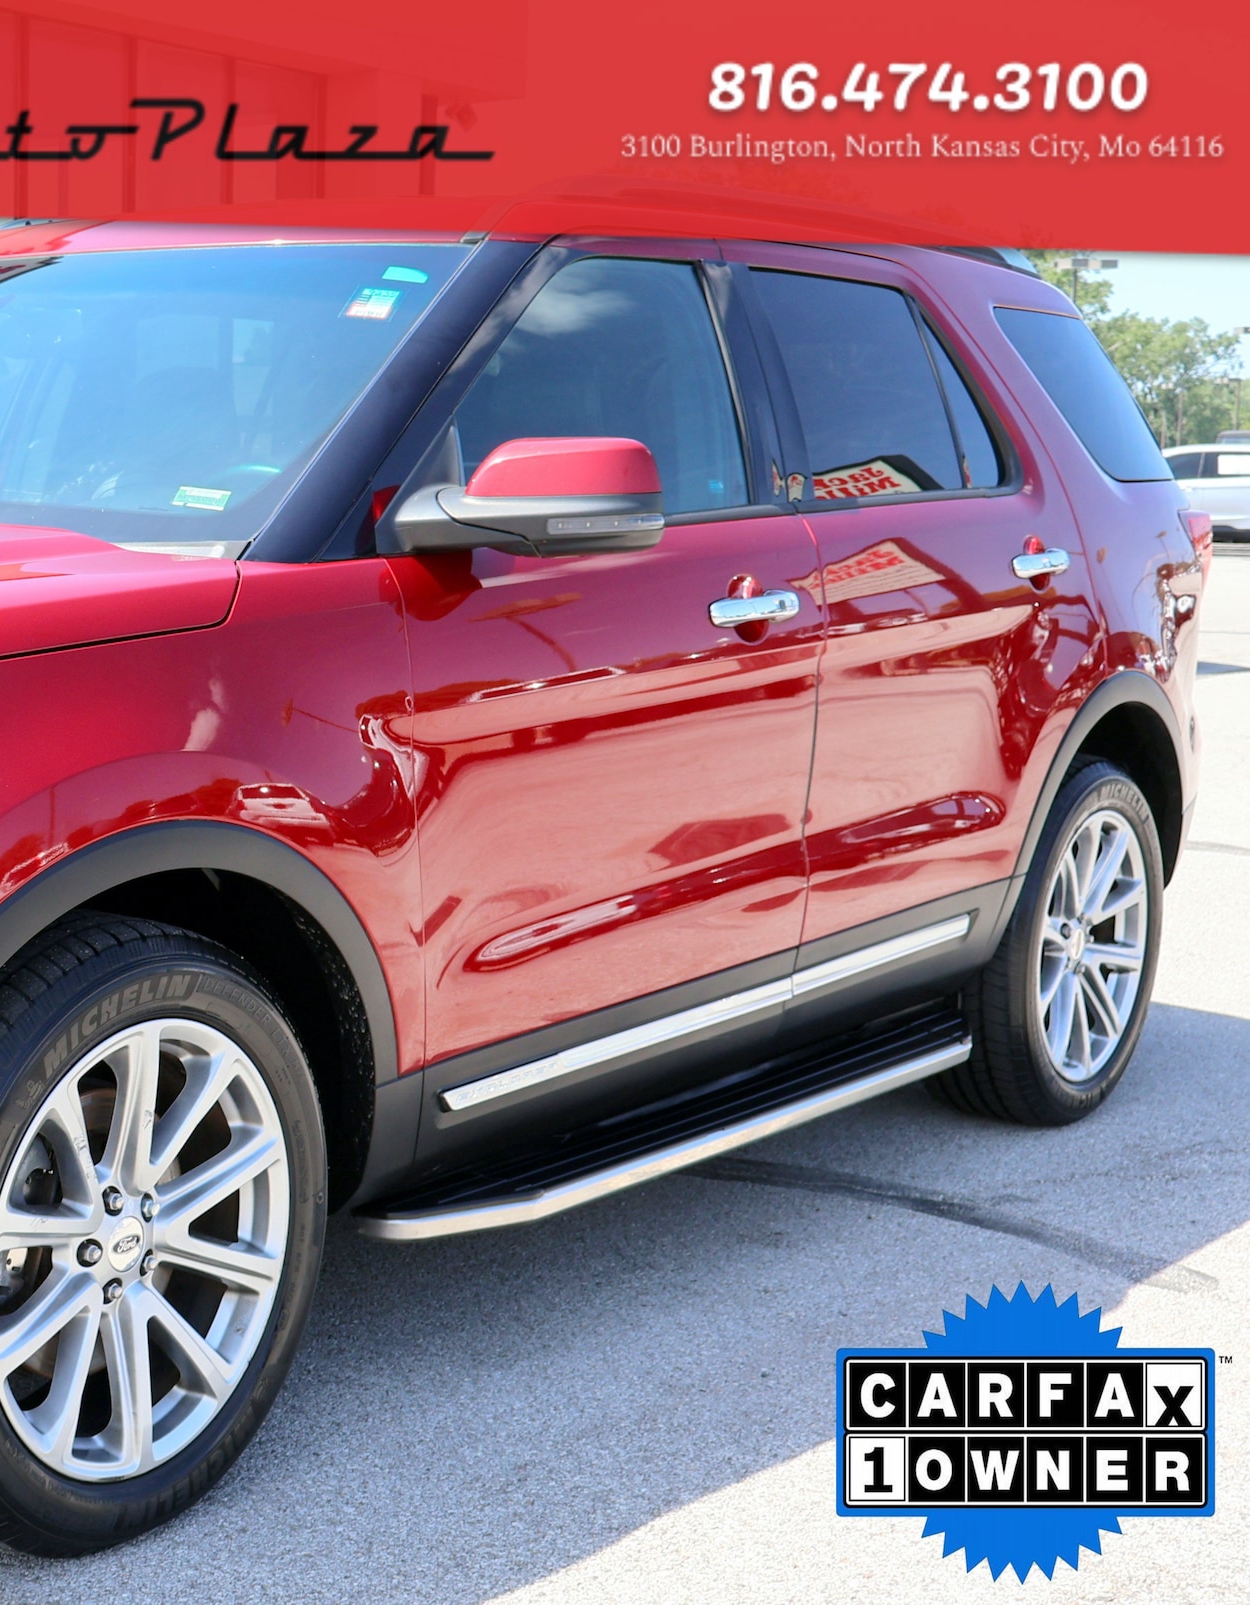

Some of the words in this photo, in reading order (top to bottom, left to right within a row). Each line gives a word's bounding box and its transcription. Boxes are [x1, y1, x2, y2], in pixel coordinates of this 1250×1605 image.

[1101, 783, 1150, 823] MICHELIN
[44, 974, 193, 1079] MICHELIN
[204, 976, 272, 1028] DEFENDER
[117, 1235, 139, 1253] Ford
